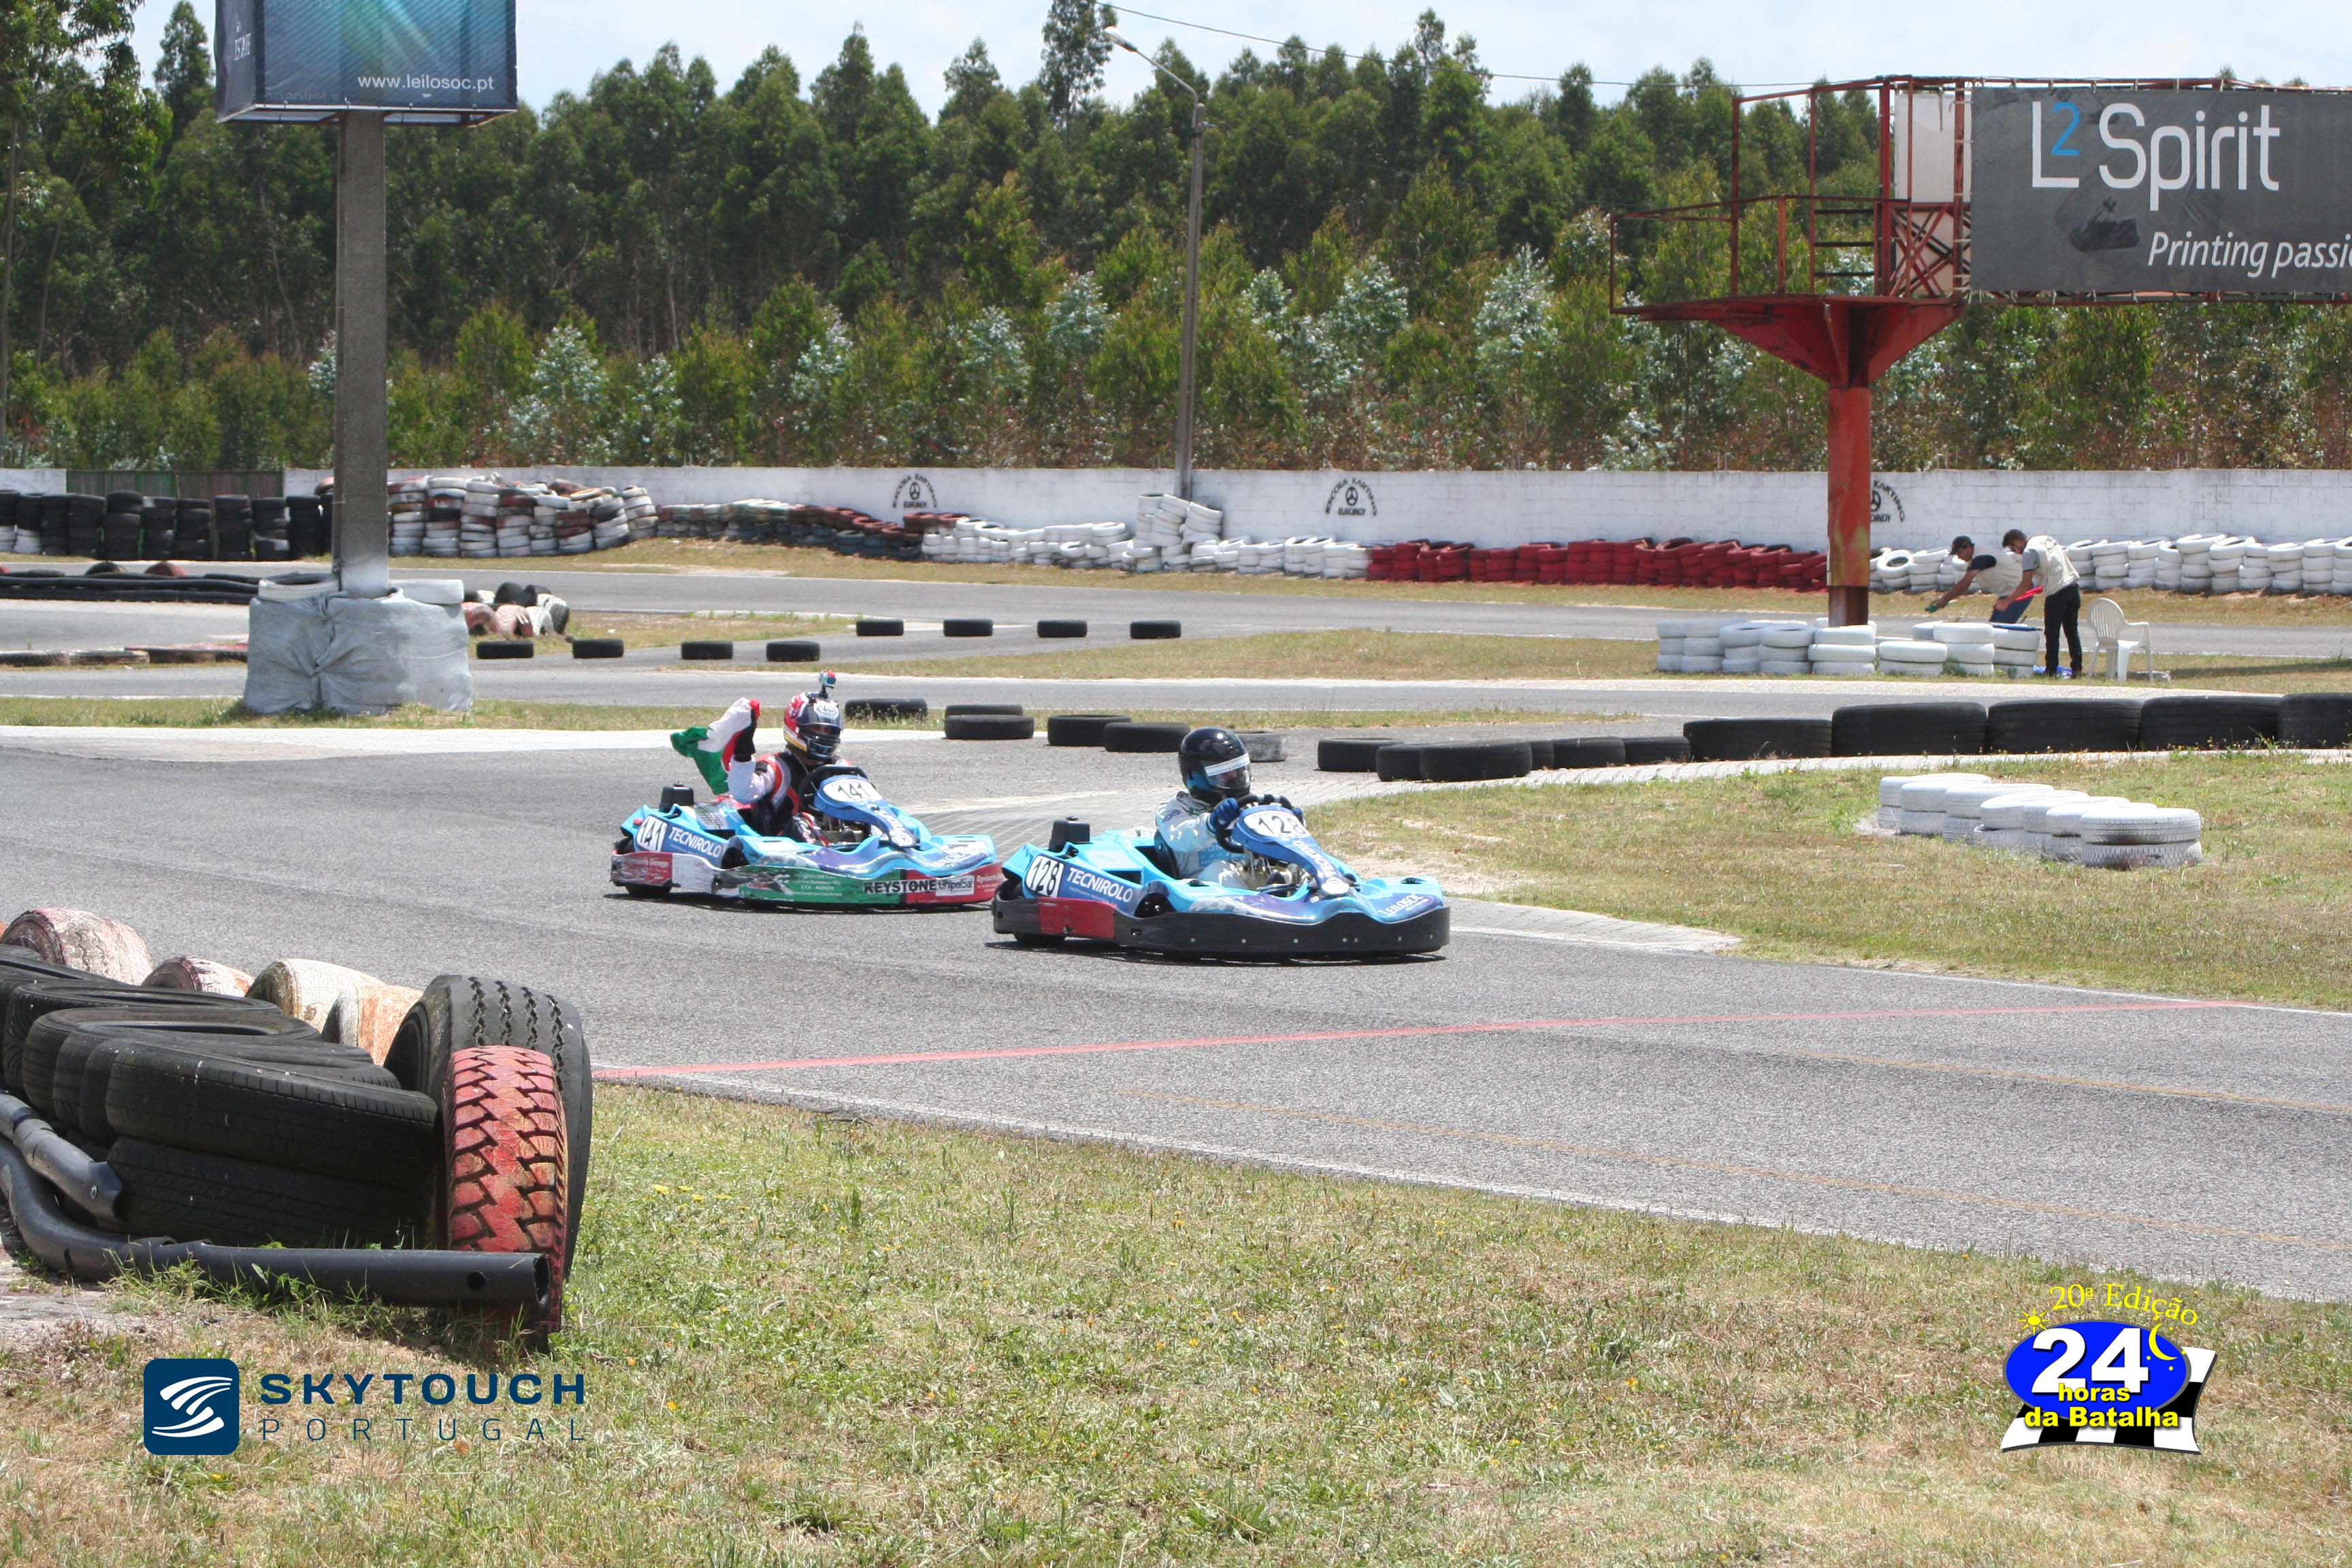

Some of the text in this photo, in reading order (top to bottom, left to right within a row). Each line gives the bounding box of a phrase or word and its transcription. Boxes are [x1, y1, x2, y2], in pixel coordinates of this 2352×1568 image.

[358, 74, 494, 93] www.leilosoc.pt
[2098, 102, 2281, 211] Spirit
[2148, 231, 2270, 278] Printing
[1873, 479, 1906, 522] KARTING
[838, 783, 872, 800] 141
[641, 817, 664, 852] 141
[668, 826, 722, 858] TECNIROLO
[1258, 815, 1307, 834] 128
[864, 879, 936, 894] KEYSTONE
[1030, 858, 1060, 896] 128
[1067, 867, 1133, 902] TECNIROLO
